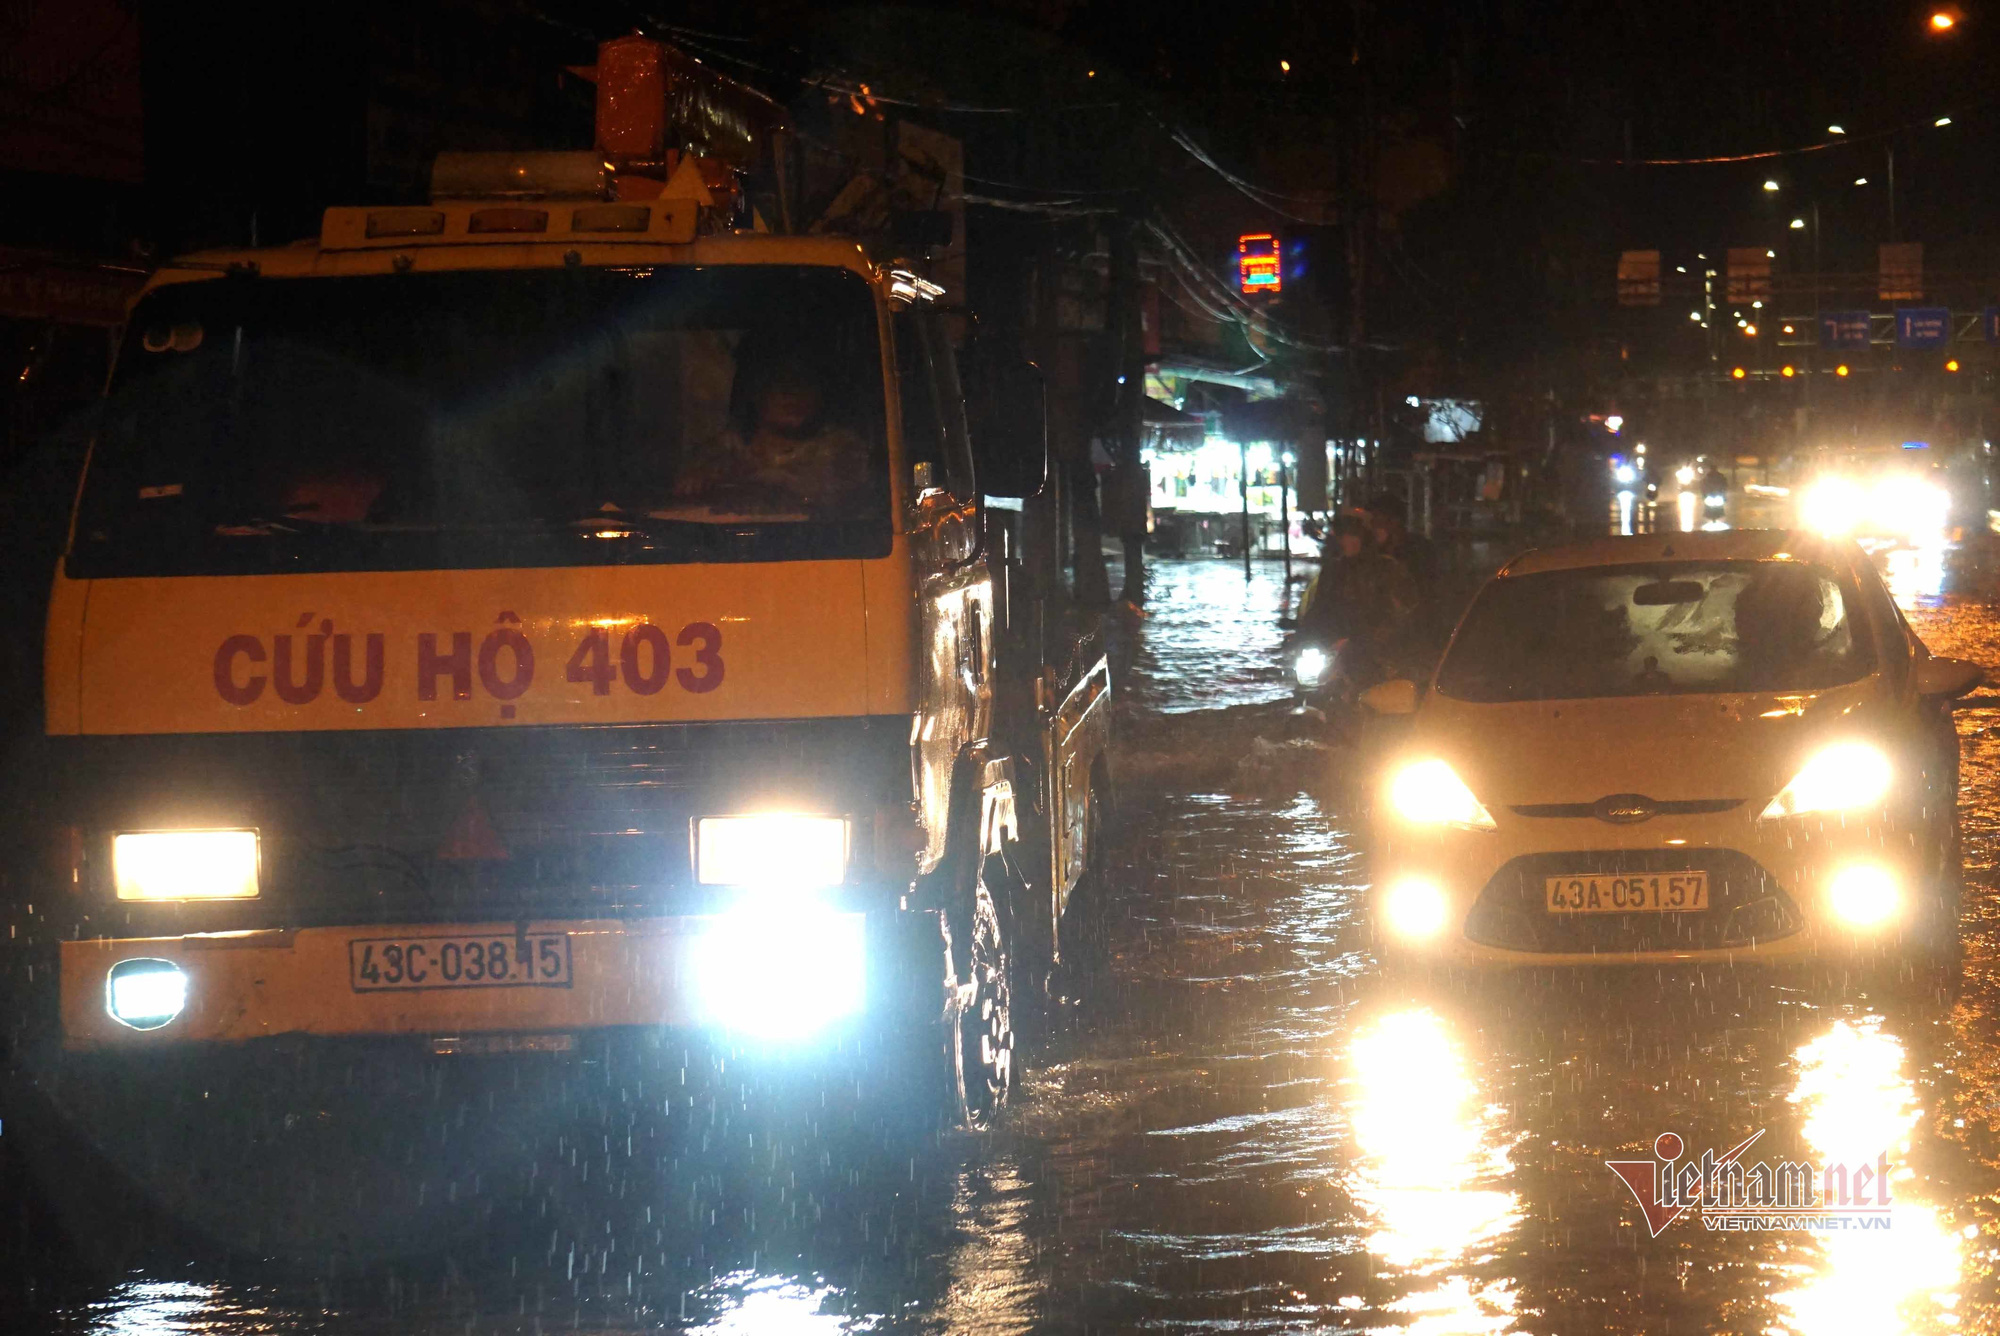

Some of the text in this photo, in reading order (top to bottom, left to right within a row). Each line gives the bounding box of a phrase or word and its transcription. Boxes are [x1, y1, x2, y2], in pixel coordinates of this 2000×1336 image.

[213, 611, 726, 719] CỨU HỘ 403
[1551, 876, 1703, 910] 43A-051.57
[359, 938, 562, 984] 43C-038.15
